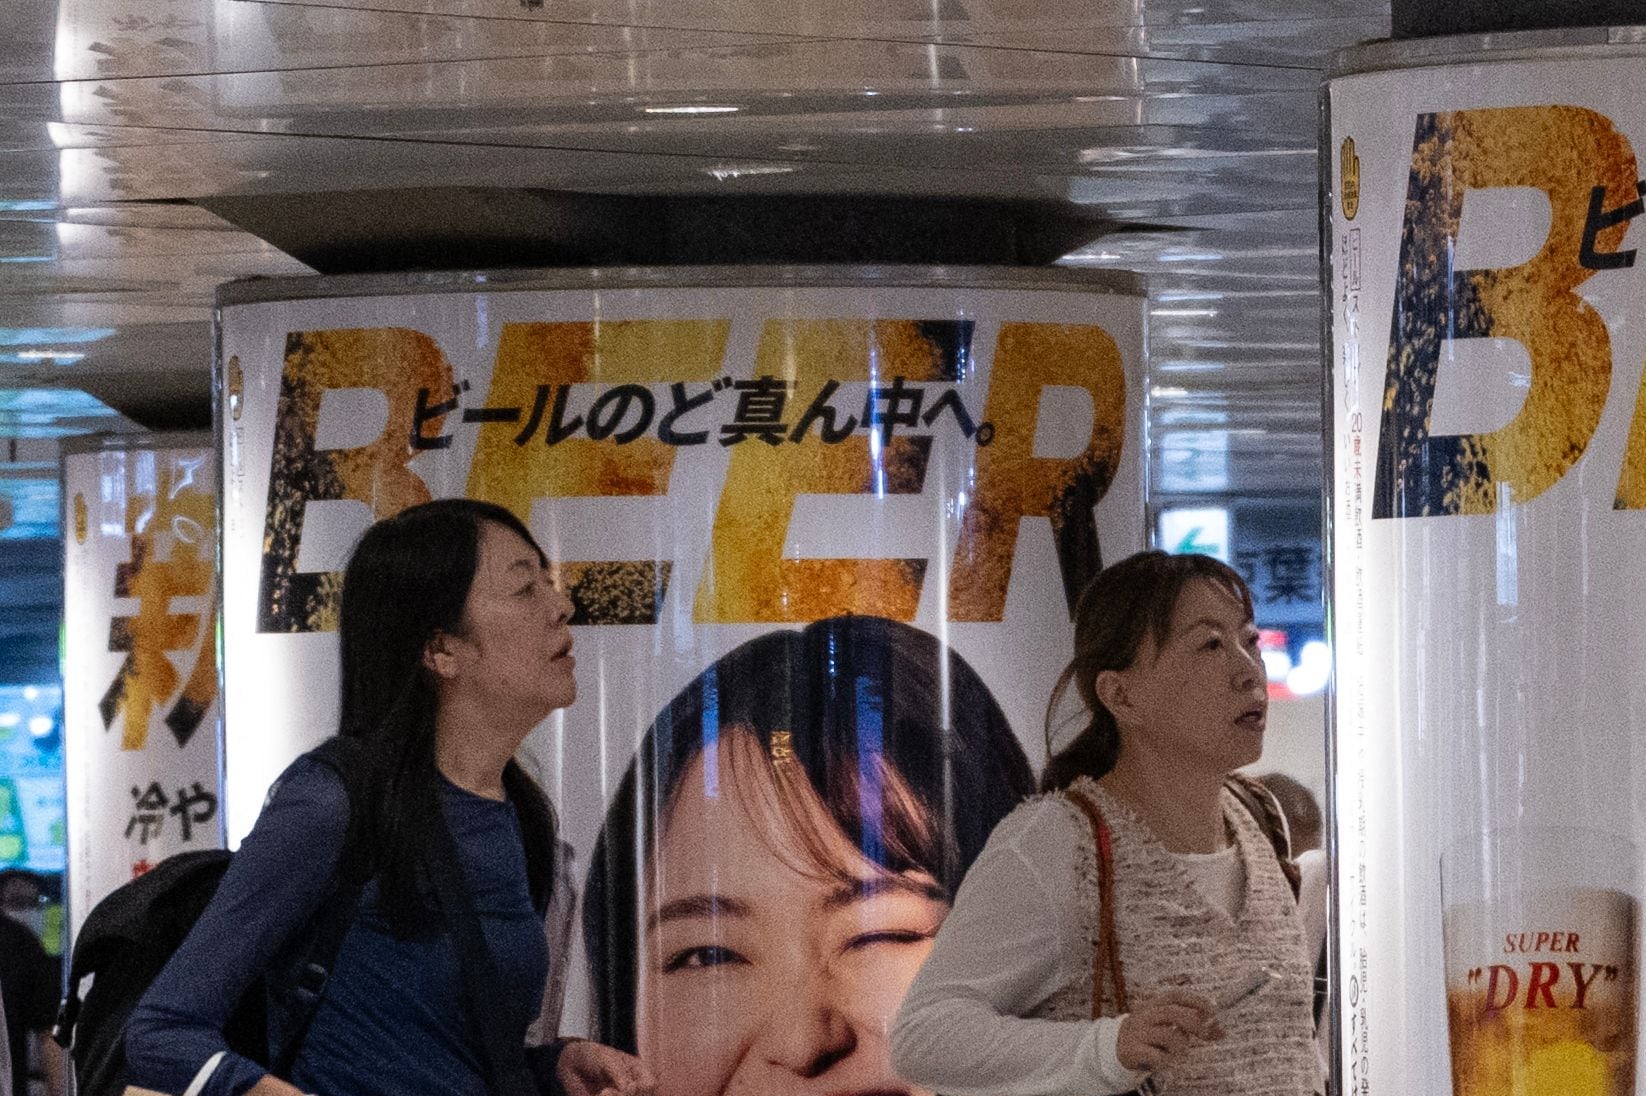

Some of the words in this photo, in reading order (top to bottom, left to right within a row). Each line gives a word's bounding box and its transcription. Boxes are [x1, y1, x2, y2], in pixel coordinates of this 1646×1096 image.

[409, 375, 997, 450] ビールのど真ん中へ。
[257, 318, 1126, 634] BEER
[124, 780, 216, 844] 冷や
[1503, 931, 1581, 954] SUPER
